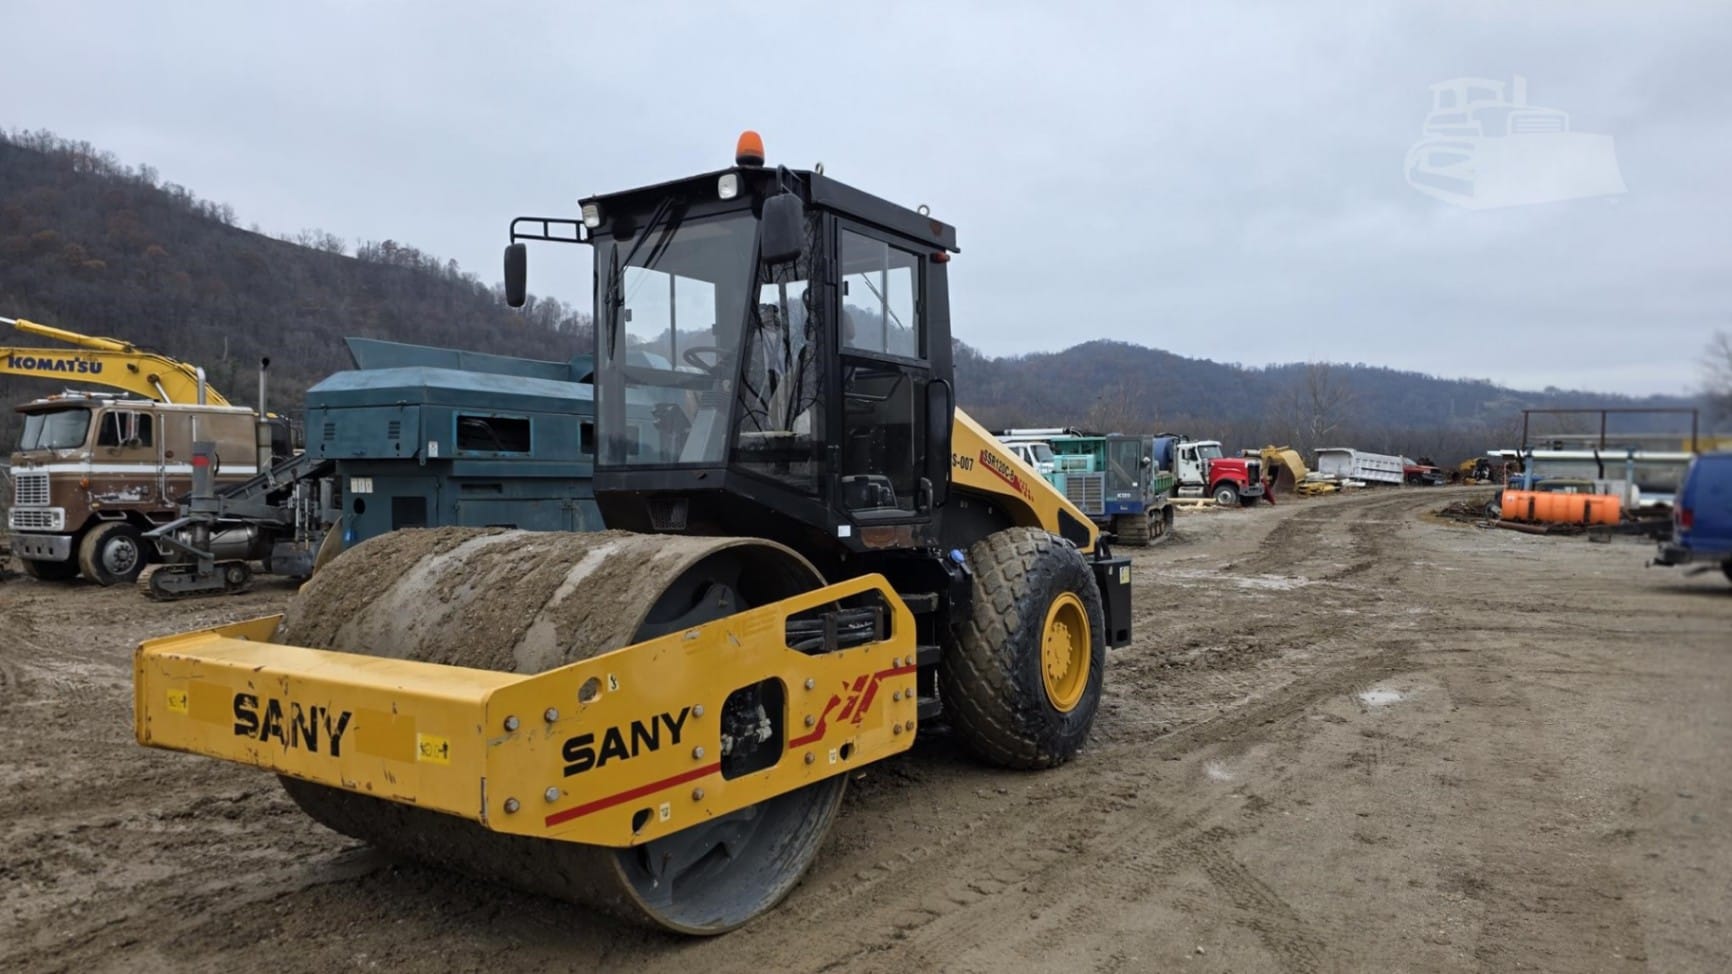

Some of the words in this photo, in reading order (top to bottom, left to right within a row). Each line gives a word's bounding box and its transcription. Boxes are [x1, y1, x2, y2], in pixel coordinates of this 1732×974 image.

[8, 355, 103, 374] KOMATSU
[233, 692, 352, 757] SANY
[562, 706, 691, 778] SANY
